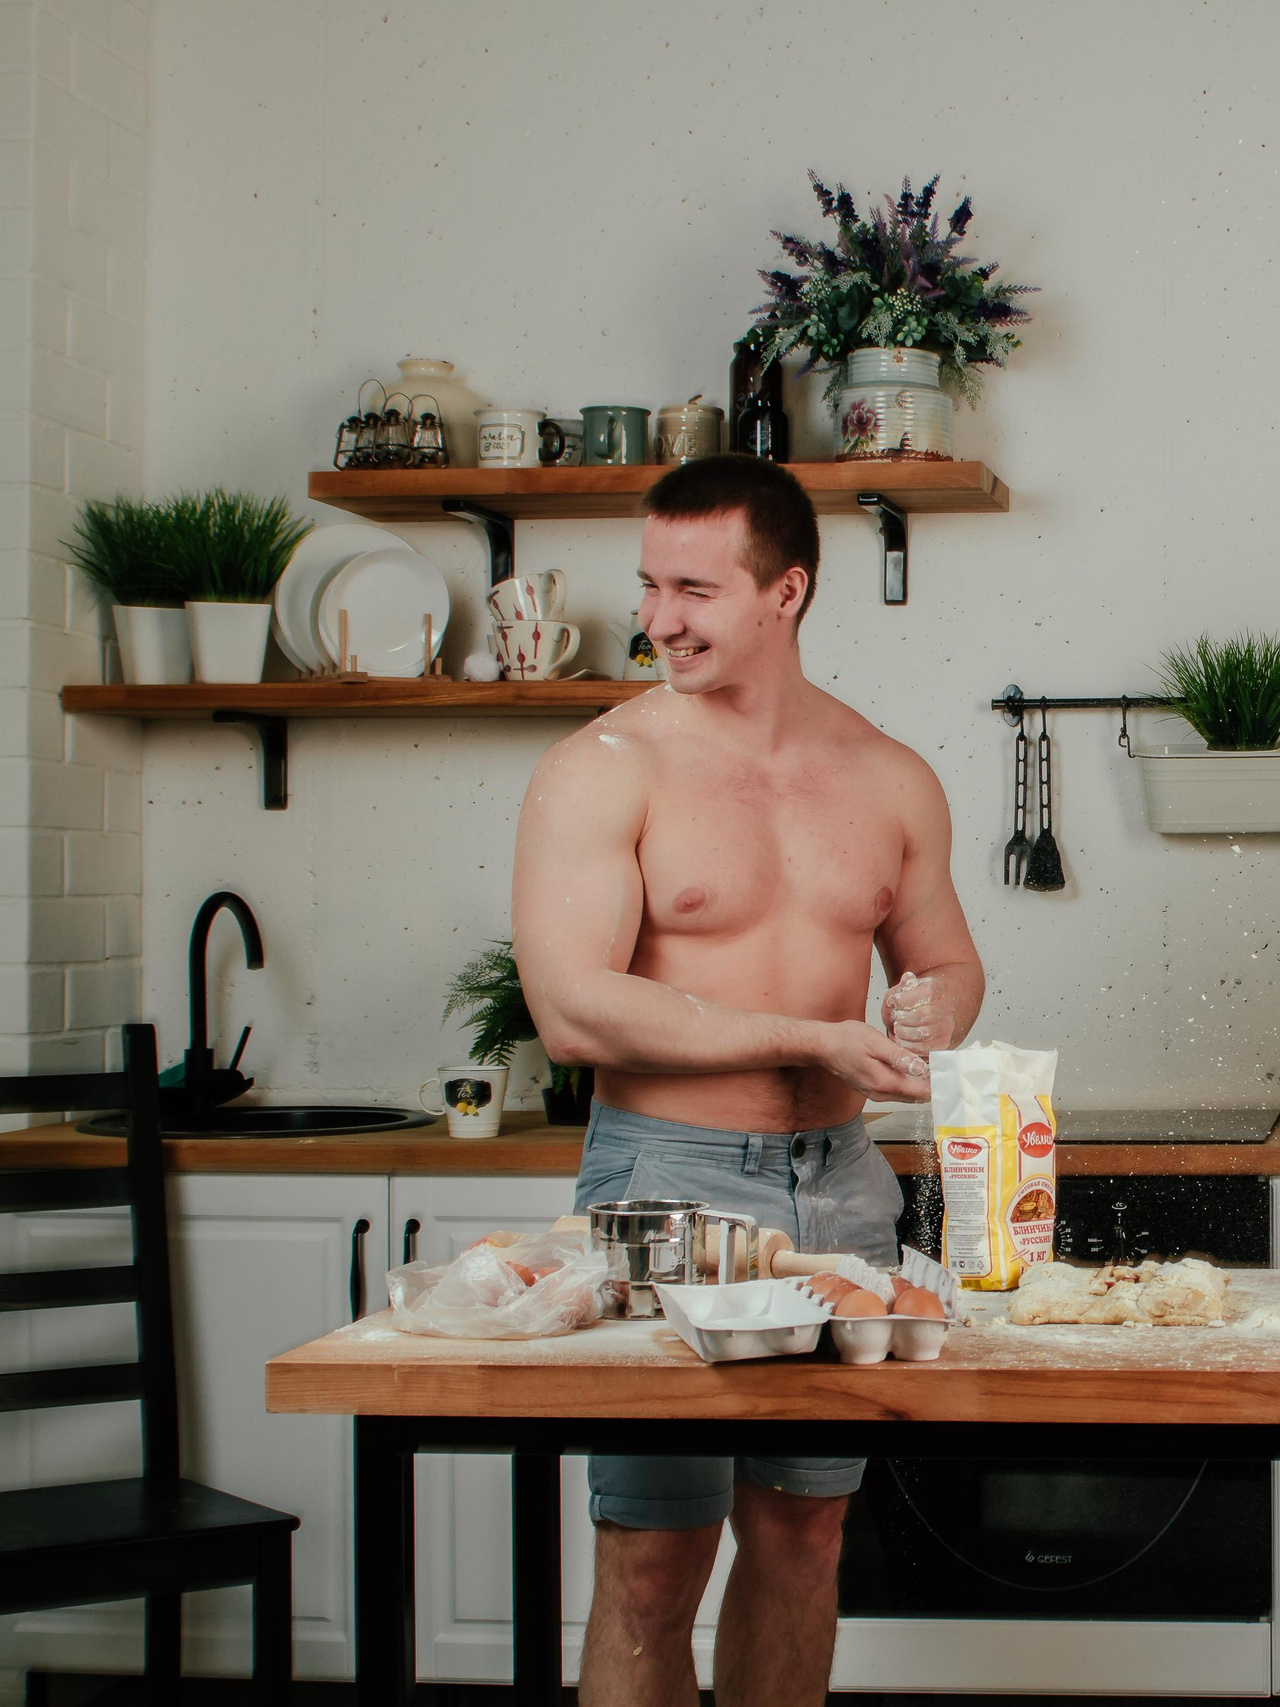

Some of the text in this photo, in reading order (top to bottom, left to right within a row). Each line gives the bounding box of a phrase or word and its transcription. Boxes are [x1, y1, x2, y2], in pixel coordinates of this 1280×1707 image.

[655, 432, 696, 456] OVE
[951, 1144, 978, 1154] Увелка
[1017, 1181, 1041, 1197] ГОТОВАЯ
[1029, 1251, 1035, 1262] 1
[1036, 1250, 1046, 1261] КГ
[1037, 1555, 1073, 1564] GEFEST
